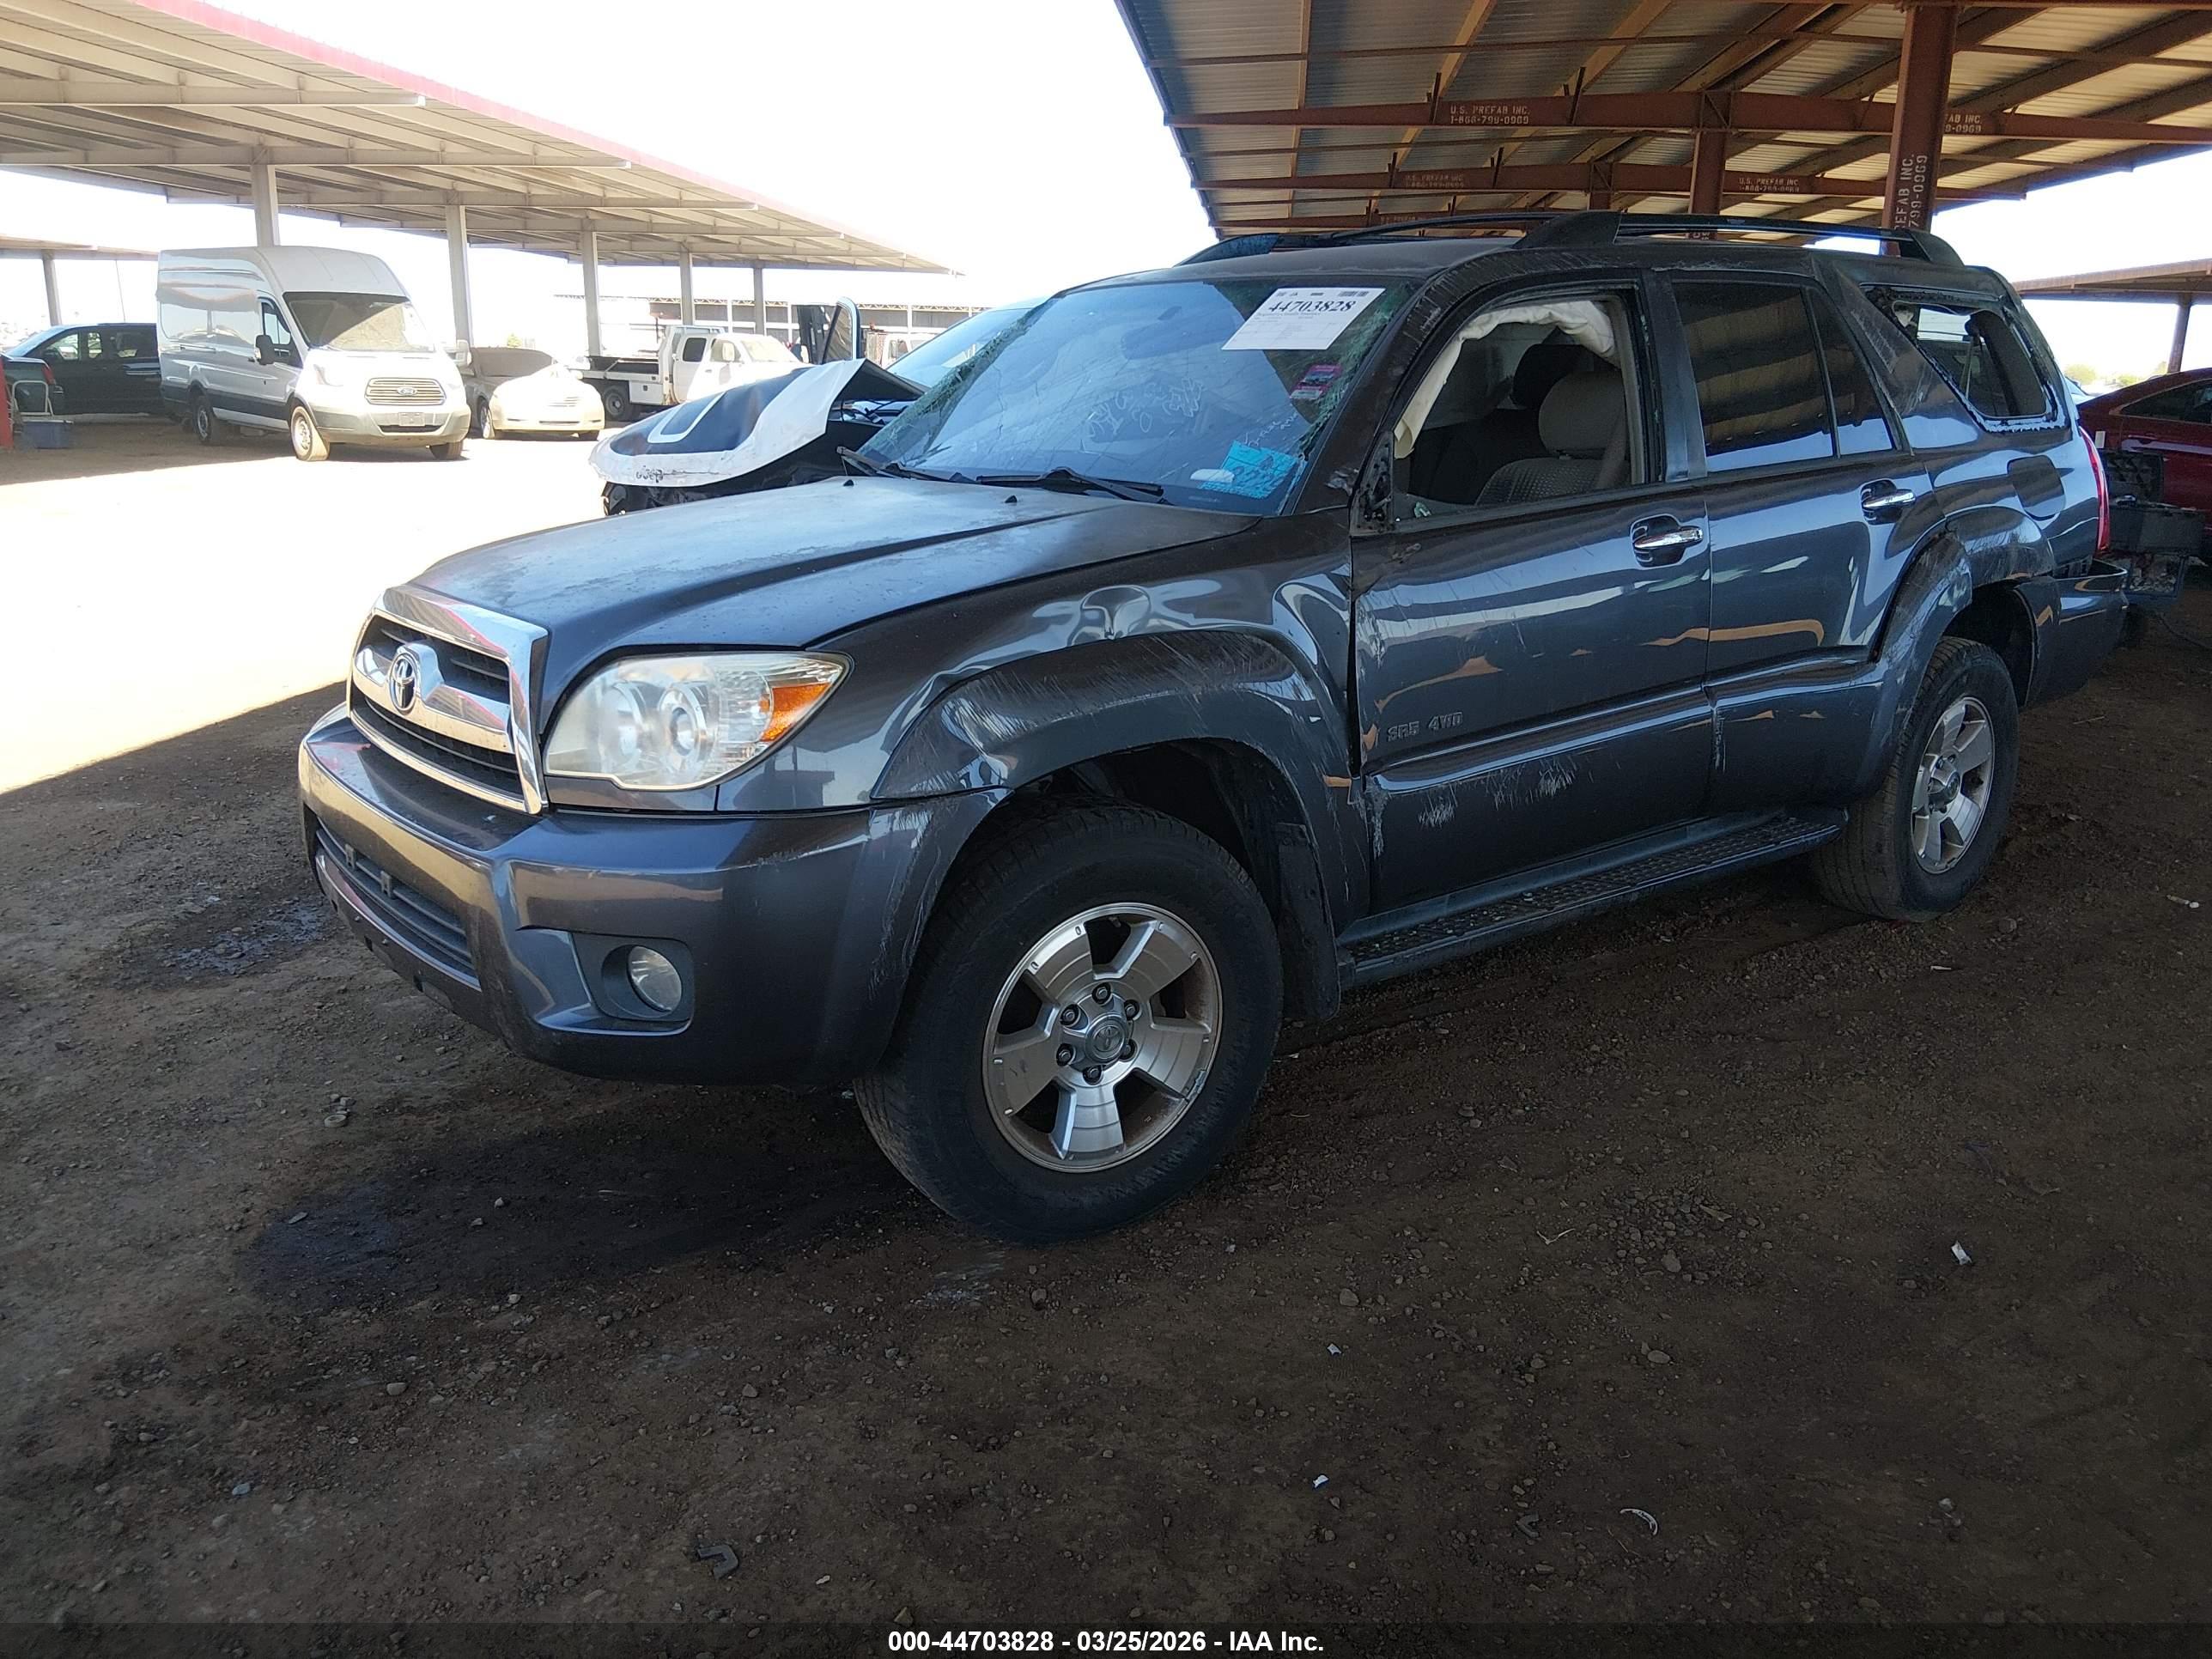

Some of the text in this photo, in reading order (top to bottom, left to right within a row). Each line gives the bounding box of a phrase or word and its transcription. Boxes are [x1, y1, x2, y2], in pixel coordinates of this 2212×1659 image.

[1450, 105, 1530, 115] U.S. PREFAB INC.
[1965, 114, 1983, 125] INC.
[1900, 154, 1915, 180] INC.
[1908, 155, 1928, 228] 799-0969
[1268, 301, 1357, 313] 44703828
